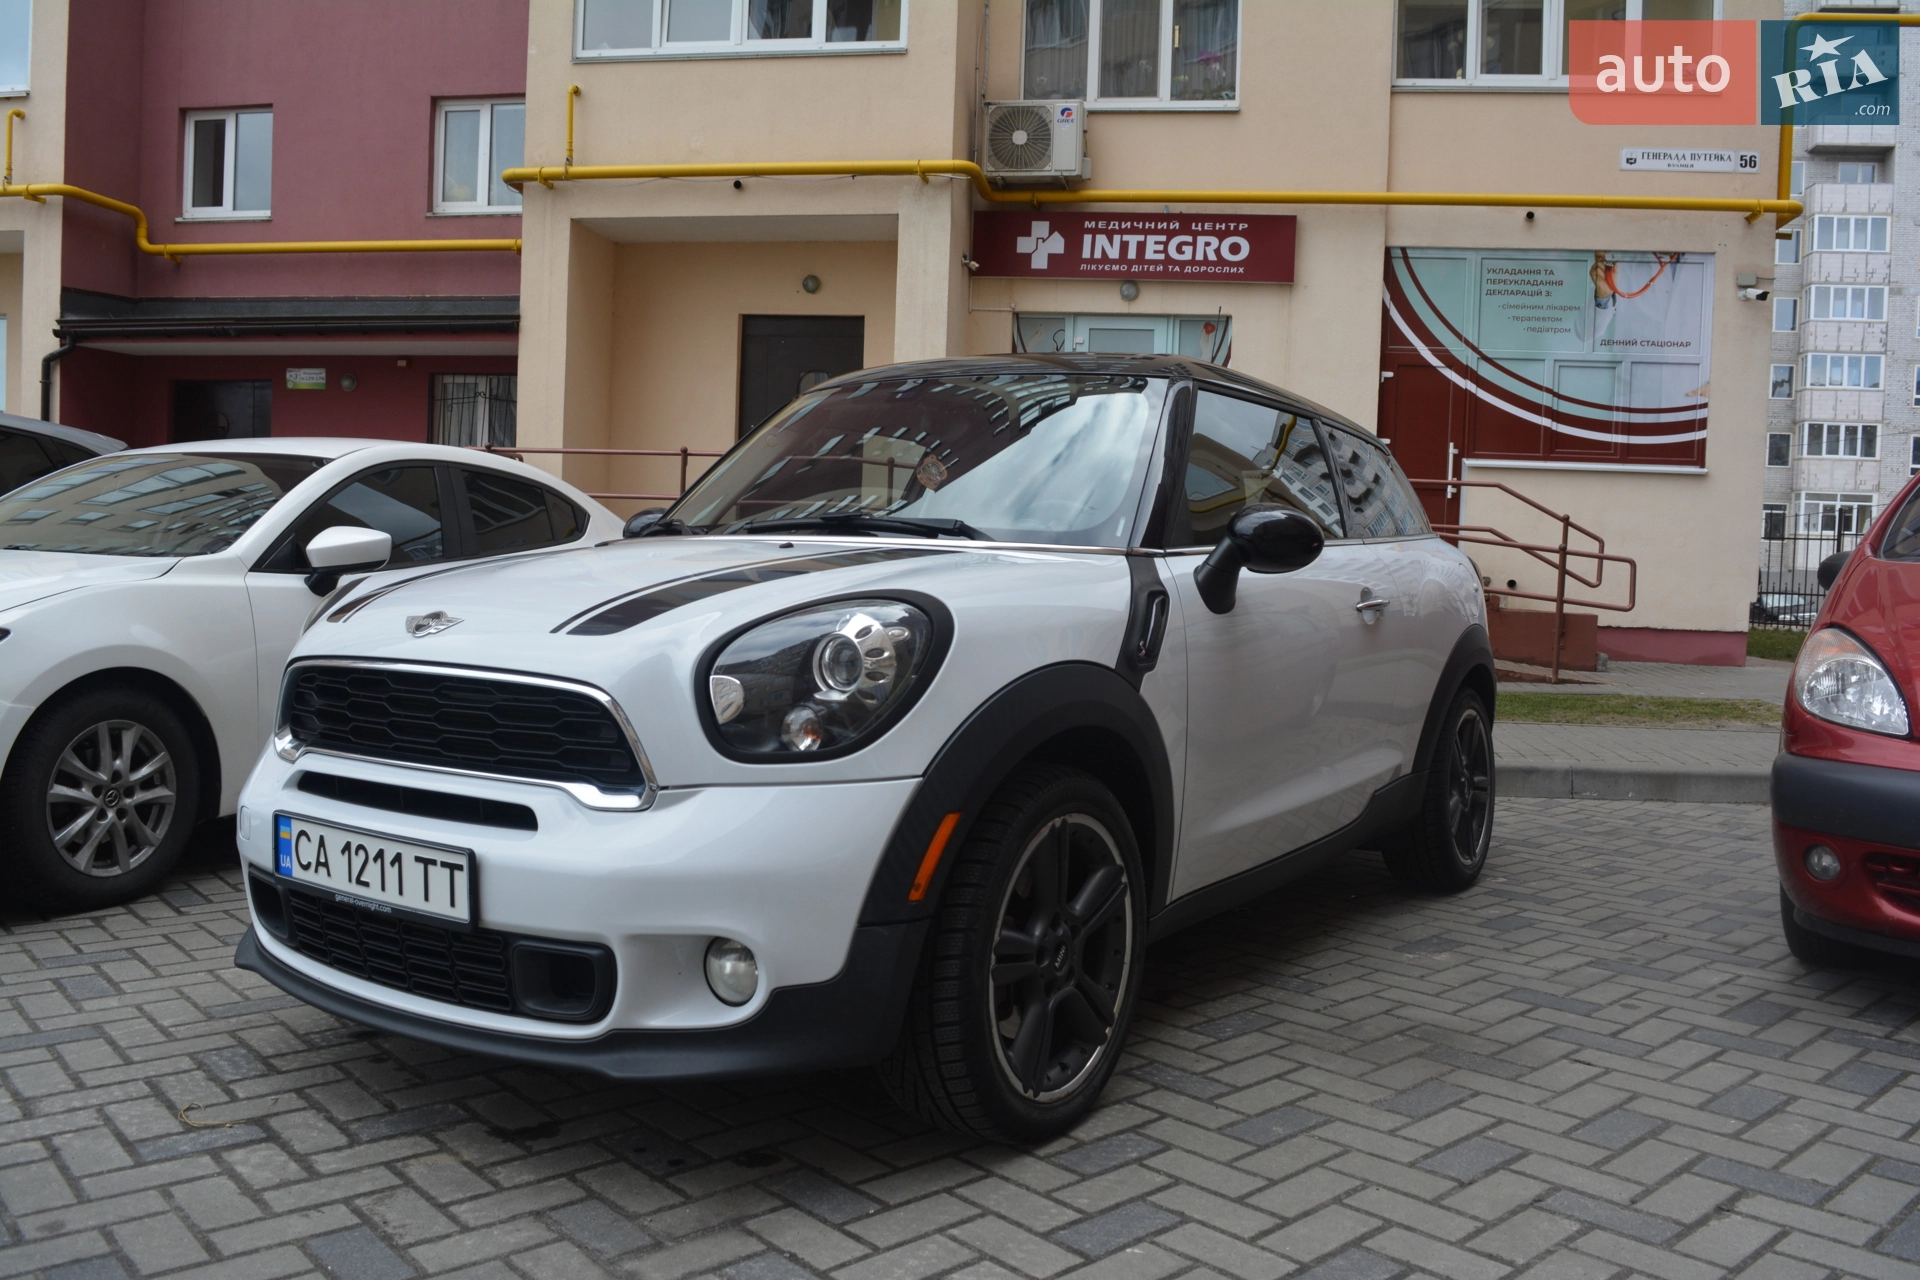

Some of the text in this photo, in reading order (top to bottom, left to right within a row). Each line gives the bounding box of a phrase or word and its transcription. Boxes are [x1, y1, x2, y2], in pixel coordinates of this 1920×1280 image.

[1690, 152, 1732, 162] ПУТЕЙКА
[1739, 154, 1757, 169] 56
[1084, 220, 1249, 231] МЕДИЧНИЙ ЦЕНТР
[1081, 234, 1250, 262] INTEGRO
[1080, 263, 1245, 274] ЛІКУЄМО ДІТЕЙ ТА ДОРОСЛИХ
[1486, 267, 1555, 276] УКЛАДАННЯ ТА
[1486, 278, 1564, 287] ПЕРЕУКЛАДАННЯ
[1485, 288, 1543, 298] ДЕКЛАРАЦІЙ
[1546, 303, 1581, 313] лікарем
[1511, 315, 1563, 325] терапевтом
[1526, 325, 1571, 335] педіатром
[1599, 338, 1692, 349] ДЕННИЙ СТАЦІОНАР
[280, 854, 292, 869] UA
[294, 829, 464, 908] CA 1211 TT
[335, 893, 392, 914] general-overnight.com
